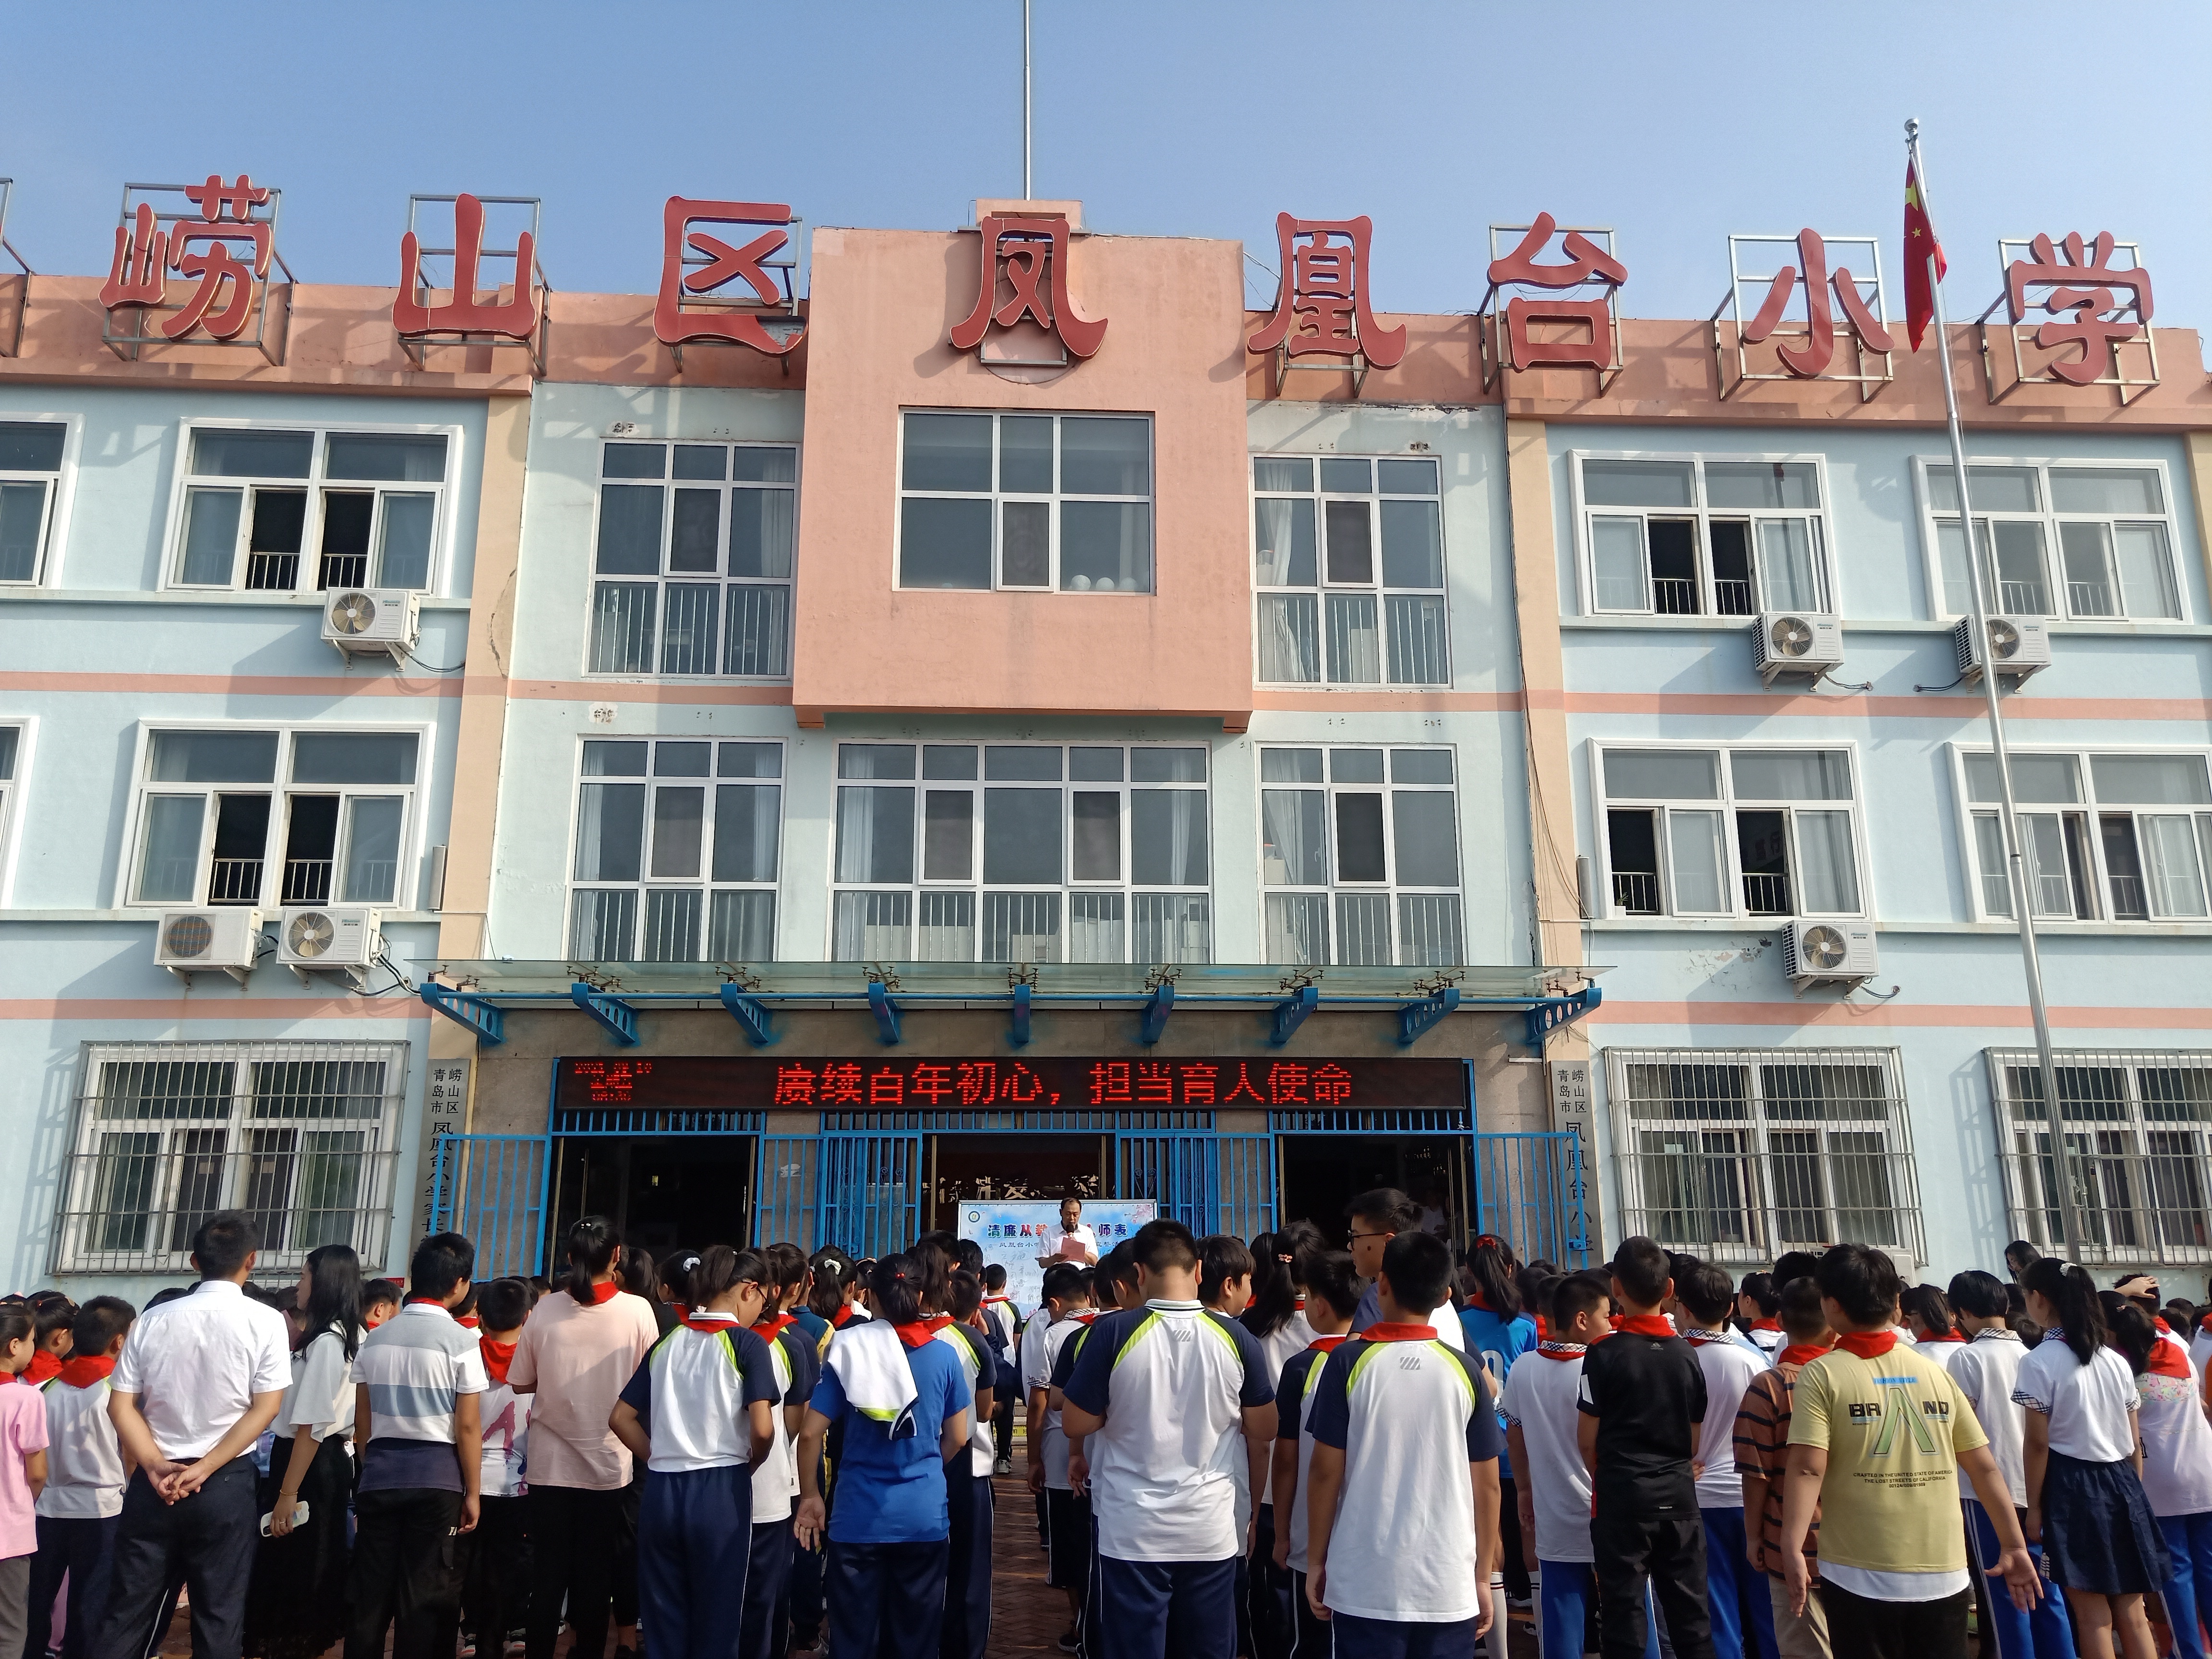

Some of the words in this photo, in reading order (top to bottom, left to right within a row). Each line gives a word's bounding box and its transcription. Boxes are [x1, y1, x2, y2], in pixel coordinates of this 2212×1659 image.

[99, 174, 2154, 387] 崂山区凤凰台小学
[431, 1069, 446, 1114] 青岛市
[446, 1068, 462, 1114] 崂山区
[1557, 1070, 1571, 1113] 青岛市
[1572, 1070, 1587, 1113] 崂山区
